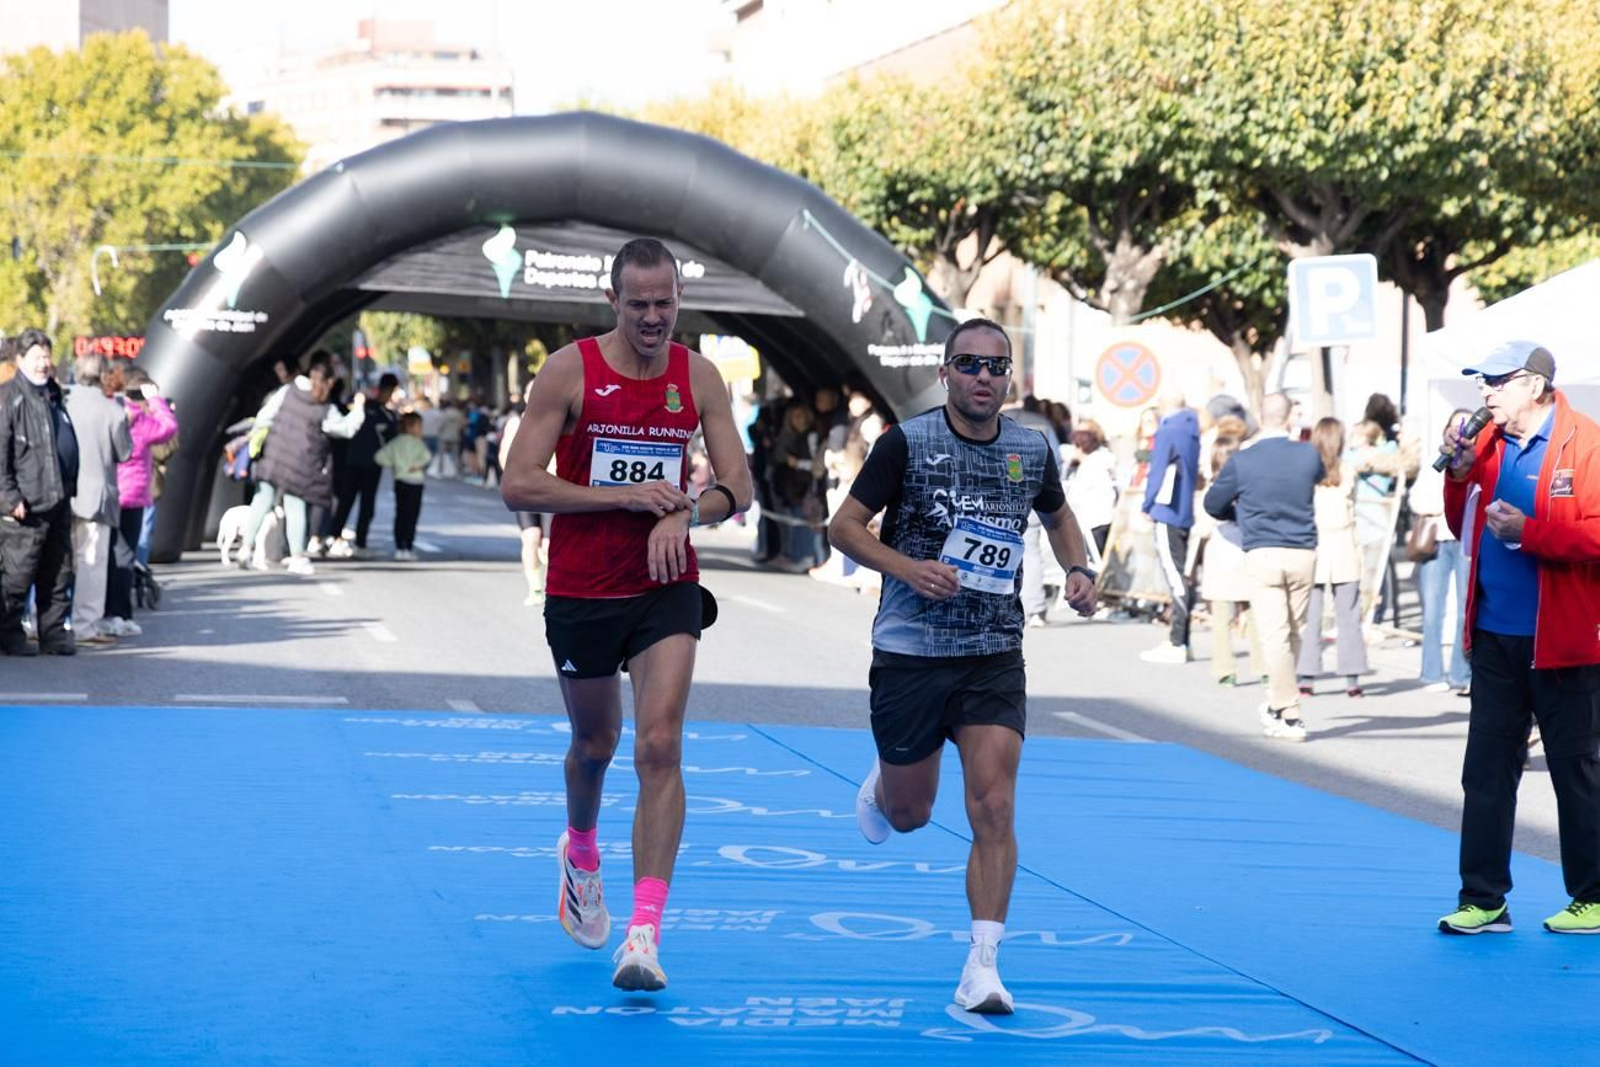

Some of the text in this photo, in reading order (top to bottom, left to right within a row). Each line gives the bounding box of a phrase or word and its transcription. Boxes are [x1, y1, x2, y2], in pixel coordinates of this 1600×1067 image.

[1307, 265, 1362, 337] P
[587, 423, 645, 437] ARJONILLA
[609, 459, 665, 483] 884
[963, 537, 1011, 569] 789
[666, 1017, 900, 1027] MEDIA
